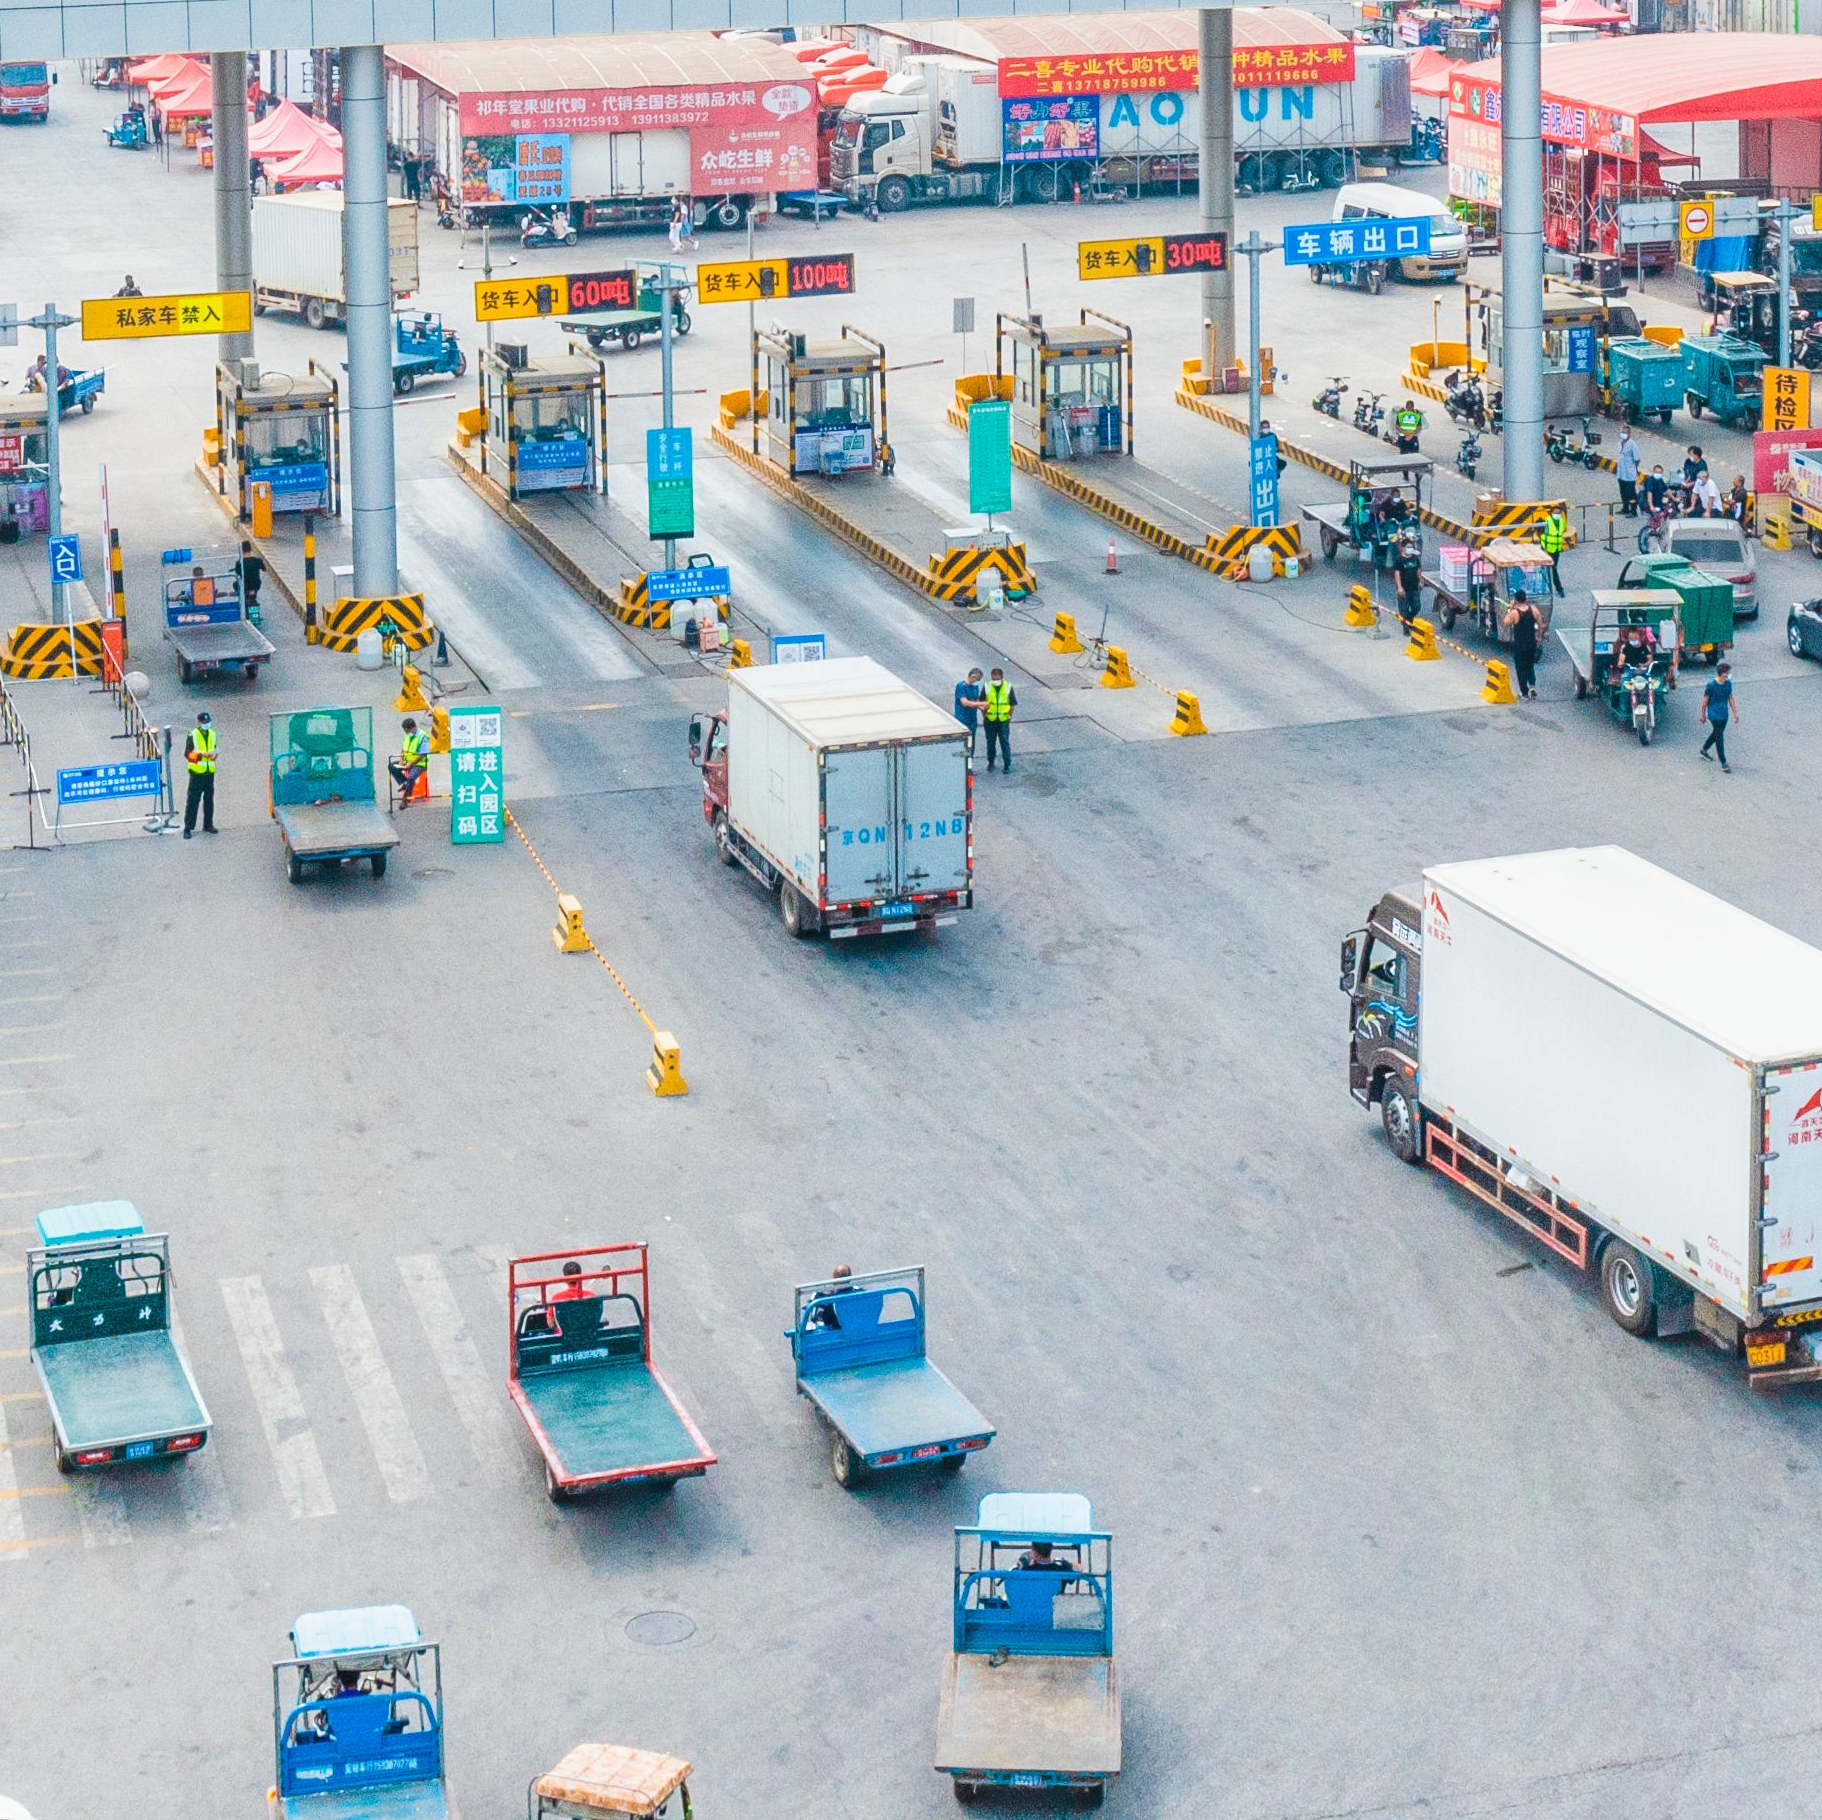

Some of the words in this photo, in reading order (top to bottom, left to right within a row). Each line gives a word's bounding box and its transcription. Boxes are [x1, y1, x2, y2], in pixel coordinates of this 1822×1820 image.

[1006, 47, 1348, 77] 二喜专业代购代销种精品水果
[601, 90, 756, 112] 代销全国各类精品水果
[1107, 86, 1314, 128] AOUN
[1167, 239, 1224, 268] 30吨
[1297, 222, 1420, 258] 车辆出口
[792, 259, 850, 291] 100吨
[571, 277, 632, 309] 60吨
[116, 305, 221, 328] 私家车禁入
[55, 544, 76, 573] 入口
[456, 751, 478, 837] 请扫码
[478, 749, 499, 836] 进入园区
